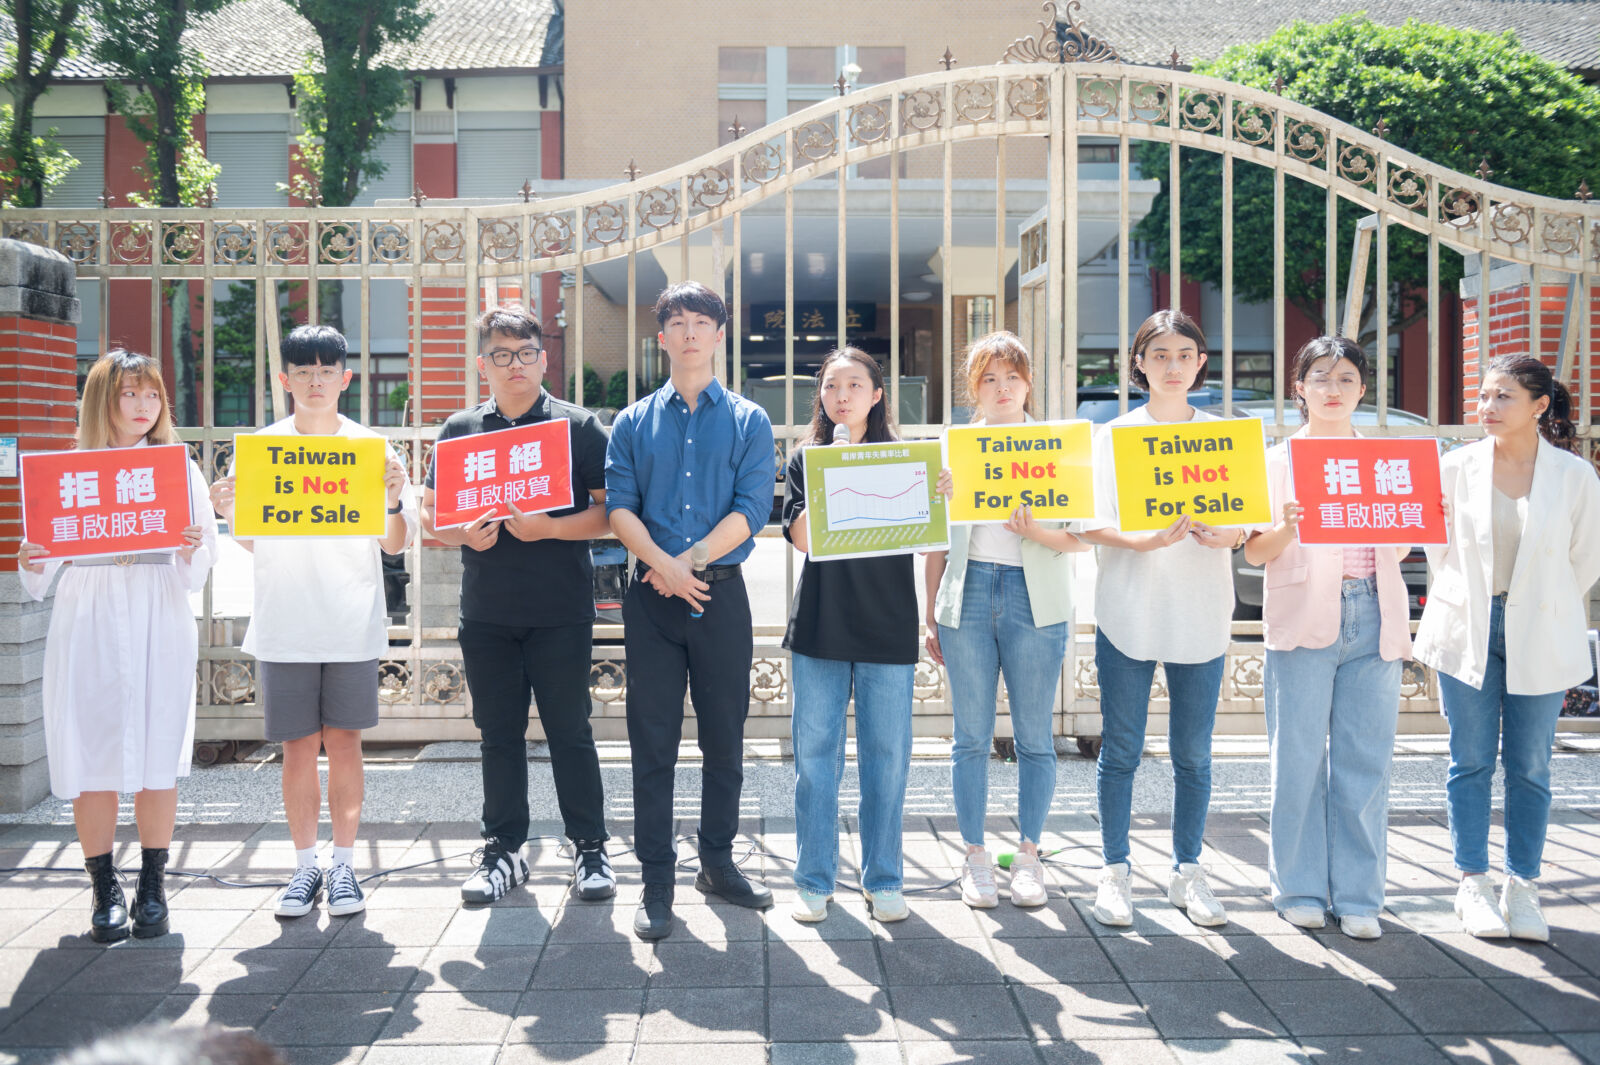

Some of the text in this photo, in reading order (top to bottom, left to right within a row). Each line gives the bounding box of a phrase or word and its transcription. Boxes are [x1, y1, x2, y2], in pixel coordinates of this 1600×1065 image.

[977, 436, 1062, 453] Taiwan
[1143, 435, 1233, 455] Taiwan
[267, 446, 356, 465] Taiwan
[464, 440, 543, 483] 拒絕
[984, 462, 1056, 480] is Not
[1154, 464, 1229, 485] is Not
[1324, 458, 1413, 495] 拒絕
[59, 467, 156, 509] 拒絕
[275, 475, 349, 494] is Not
[456, 475, 551, 511] 重啟服貿
[974, 489, 1069, 508] For Sale
[1145, 492, 1244, 517] For Sale
[263, 504, 360, 523] For Sale
[1318, 502, 1425, 528] 重啟服貿
[51, 509, 168, 542] 重啟服貿
